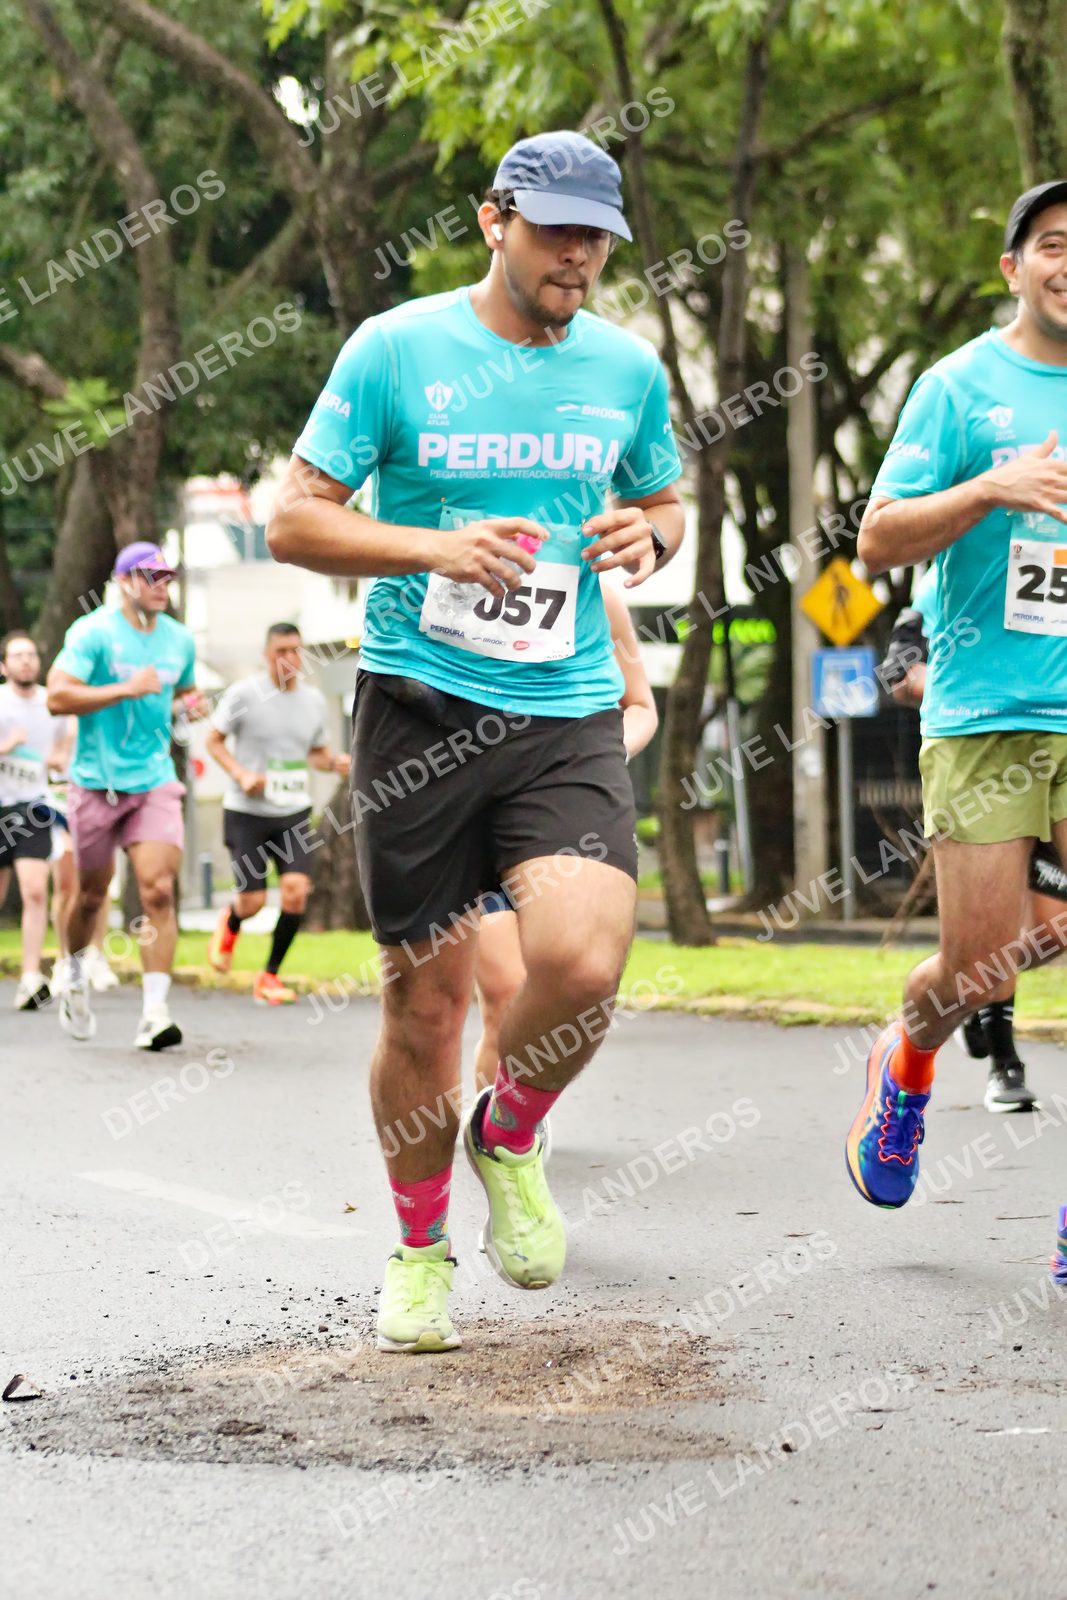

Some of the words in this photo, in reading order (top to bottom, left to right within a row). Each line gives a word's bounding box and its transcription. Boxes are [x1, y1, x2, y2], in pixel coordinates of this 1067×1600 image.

[581, 405, 626, 421] BROOKS
[418, 432, 619, 474] PERDURA
[429, 469, 457, 479] PEGA
[458, 470, 491, 479] PISOS
[498, 470, 570, 481] JUNTEADORES
[1016, 564, 1067, 604] 25
[430, 624, 465, 639] PERDURA
